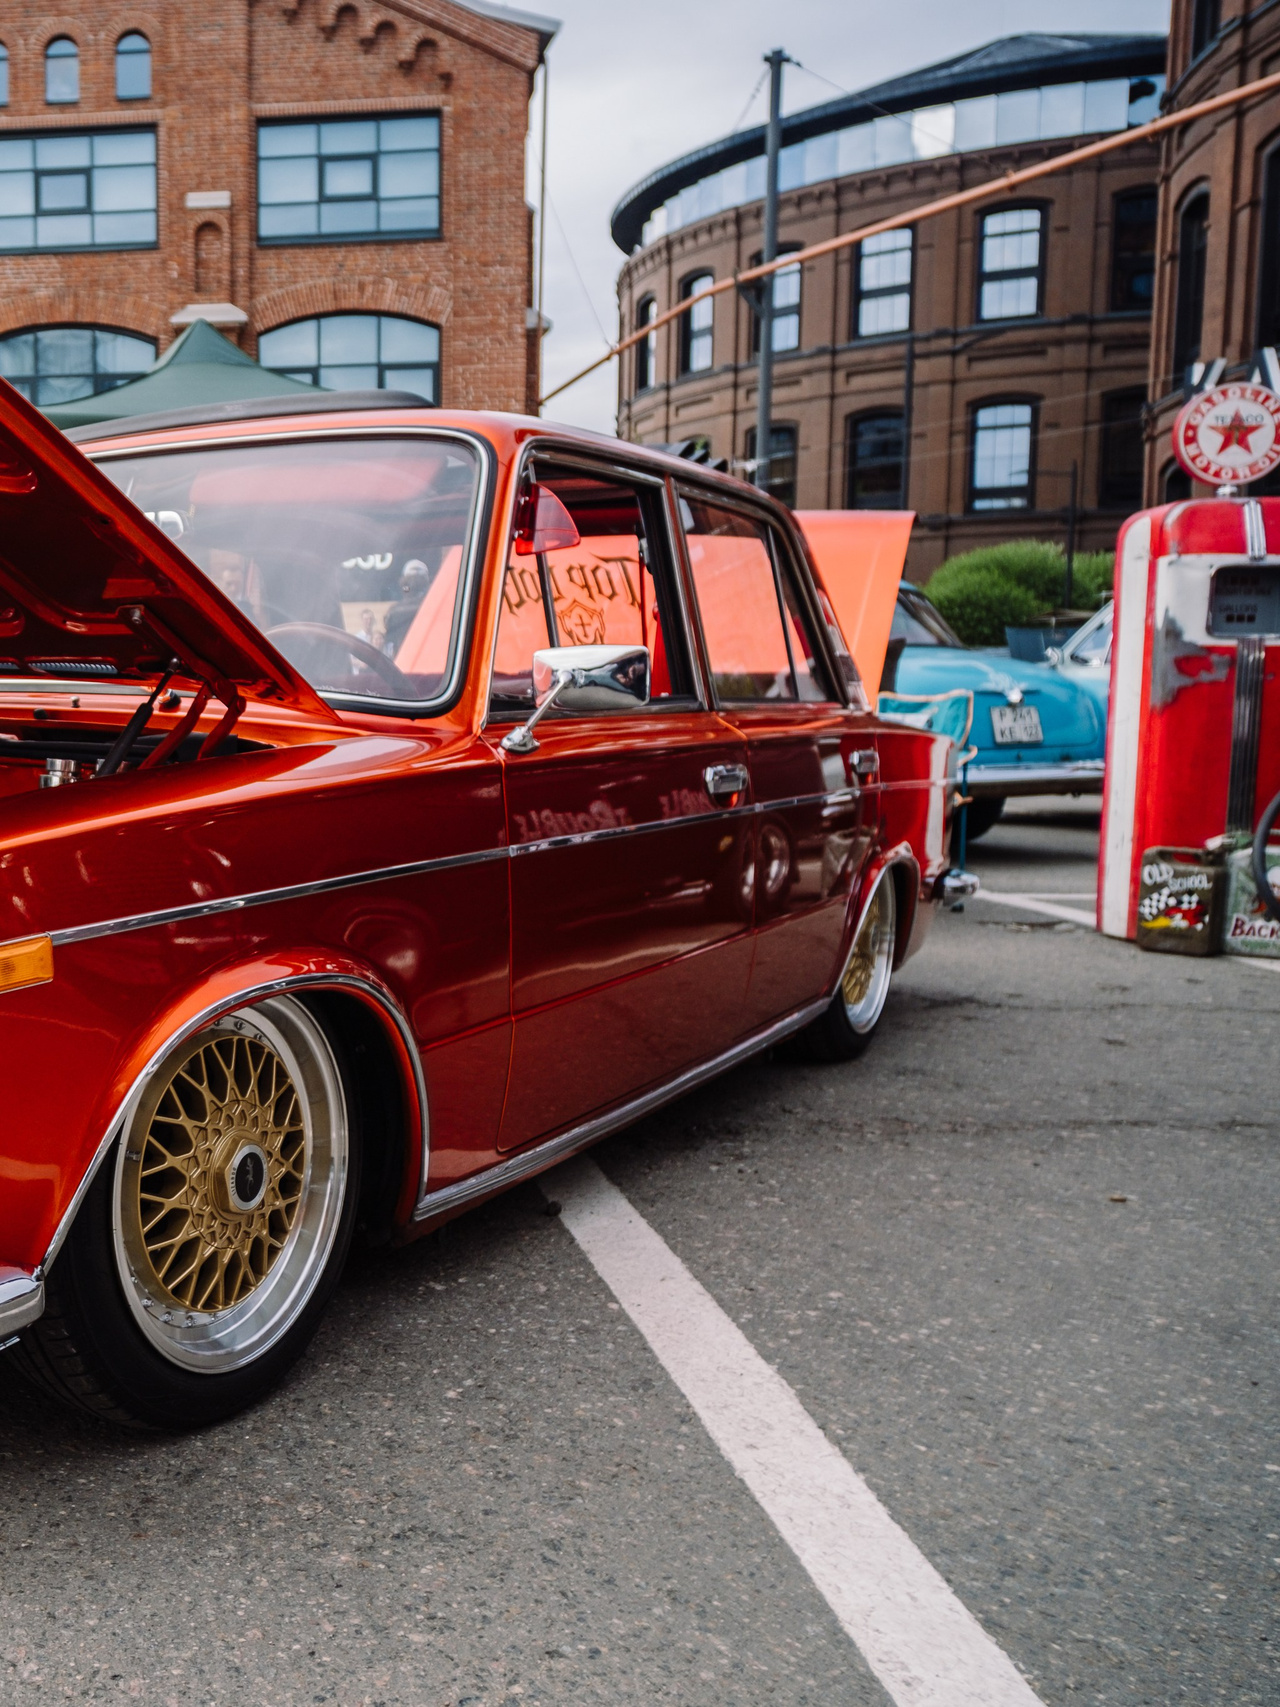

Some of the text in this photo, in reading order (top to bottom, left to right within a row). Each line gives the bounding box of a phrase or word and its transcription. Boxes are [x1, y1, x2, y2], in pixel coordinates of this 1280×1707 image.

[1186, 443, 1252, 479] MOTOR
[1142, 862, 1174, 886] OLD
[1168, 873, 1214, 893] SCHOOL
